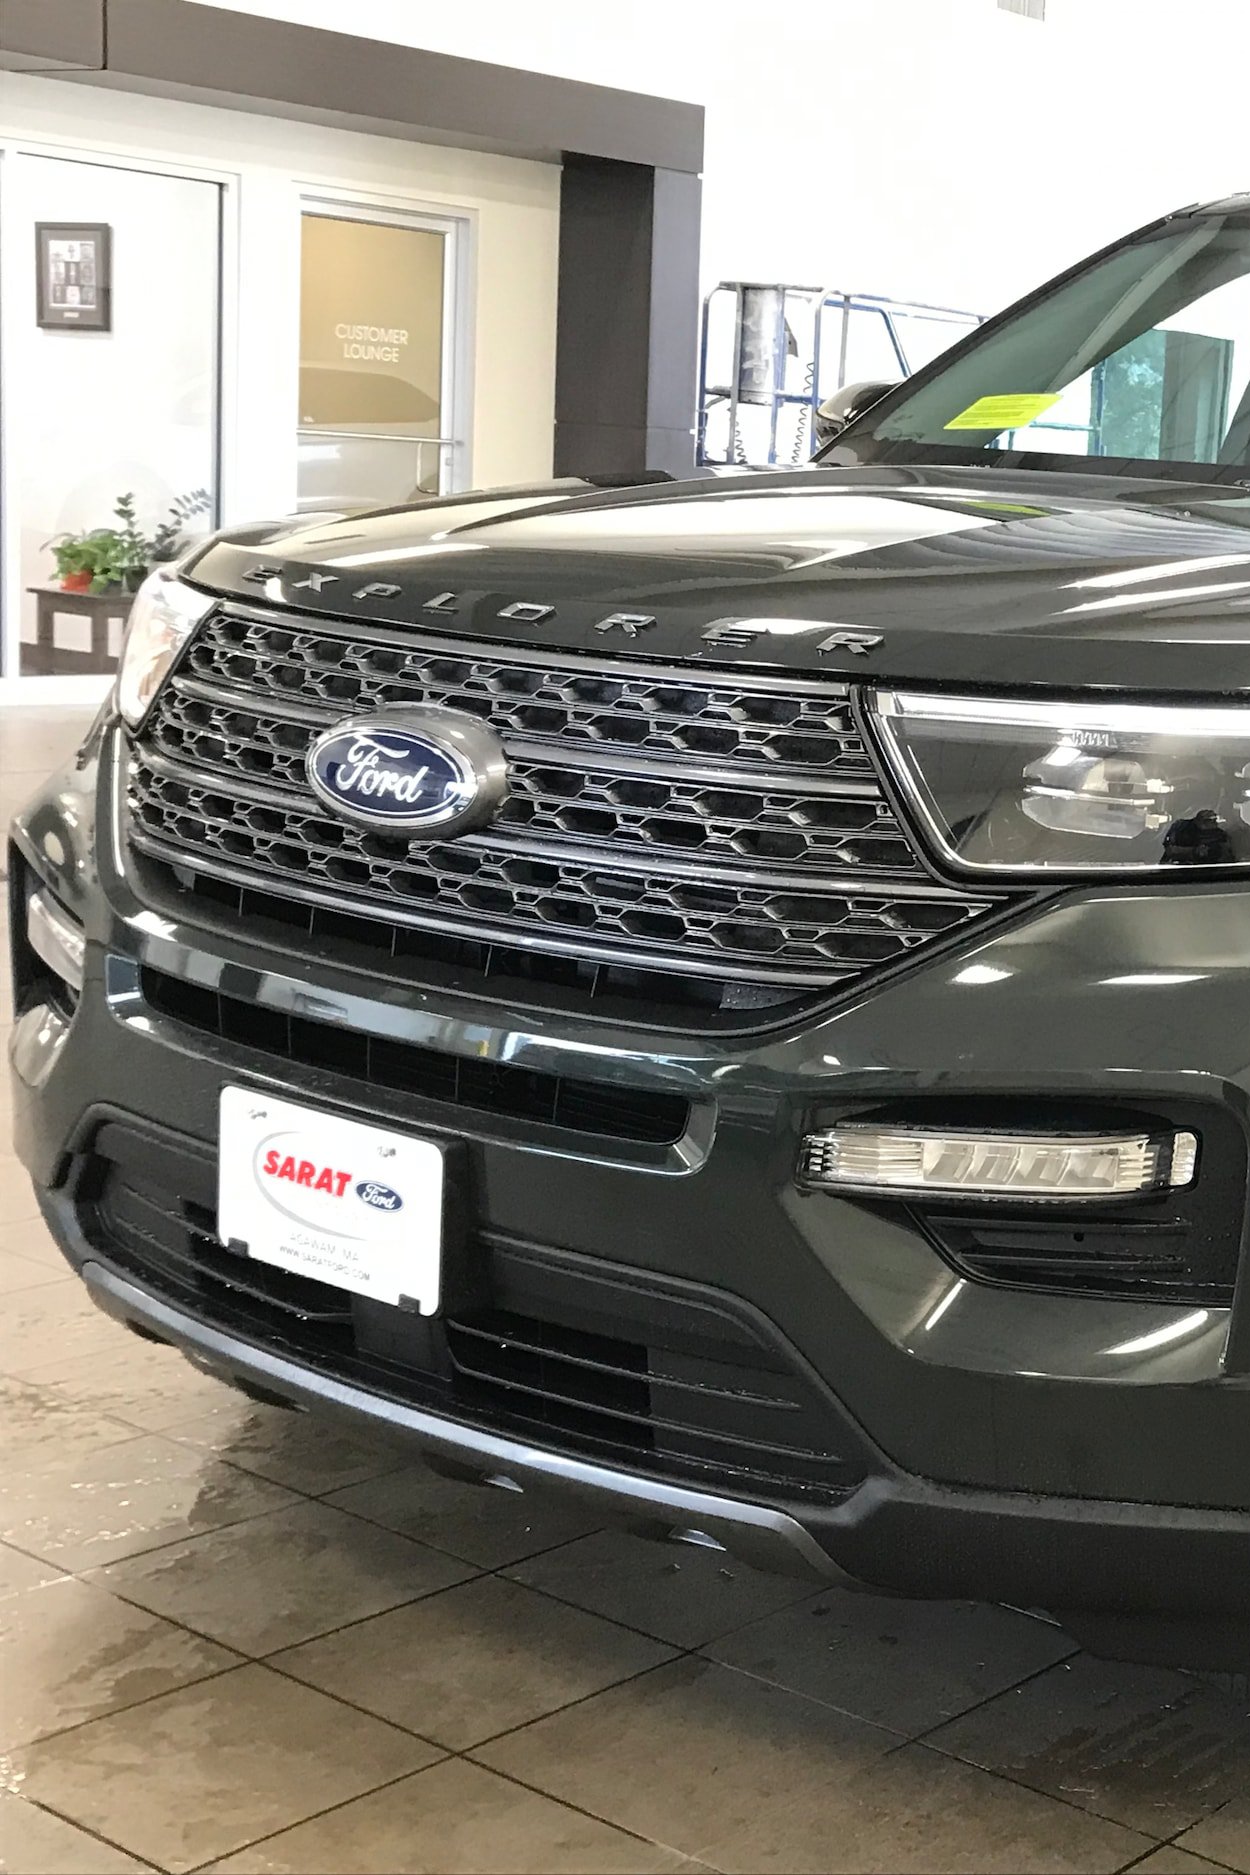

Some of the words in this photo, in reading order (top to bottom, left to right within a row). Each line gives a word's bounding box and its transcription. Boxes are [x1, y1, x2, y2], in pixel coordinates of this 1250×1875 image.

[335, 324, 408, 345] CUSTOMER
[344, 344, 399, 362] LOUNGE
[242, 565, 886, 656] EXPLORER
[335, 733, 430, 804] Ford
[263, 1150, 352, 1197] SARAT
[361, 1183, 397, 1210] Ford
